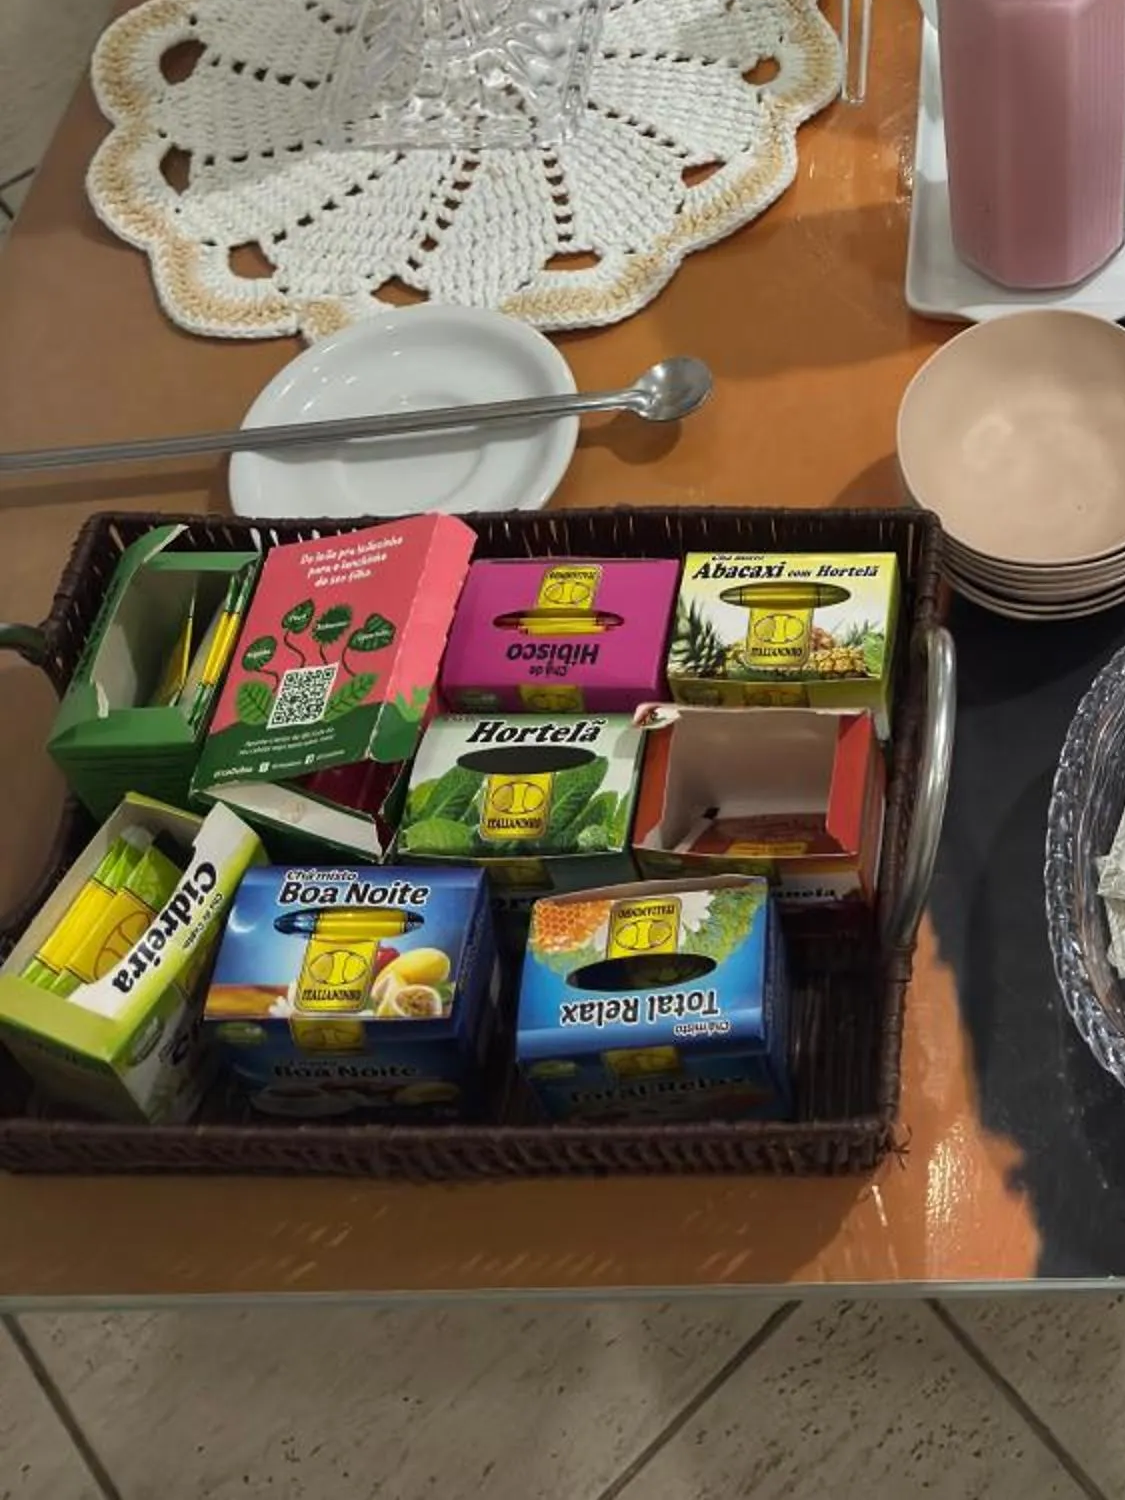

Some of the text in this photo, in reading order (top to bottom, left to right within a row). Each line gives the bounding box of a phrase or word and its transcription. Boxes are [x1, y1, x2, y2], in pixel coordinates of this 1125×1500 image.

[692, 561, 881, 580] Abacaxi com Hortelã
[506, 643, 600, 665] Hibisco
[466, 719, 608, 743] Hortelã
[279, 882, 430, 905] Boa Noite
[112, 861, 217, 993] Cidreira
[562, 991, 719, 1027] Total Relax
